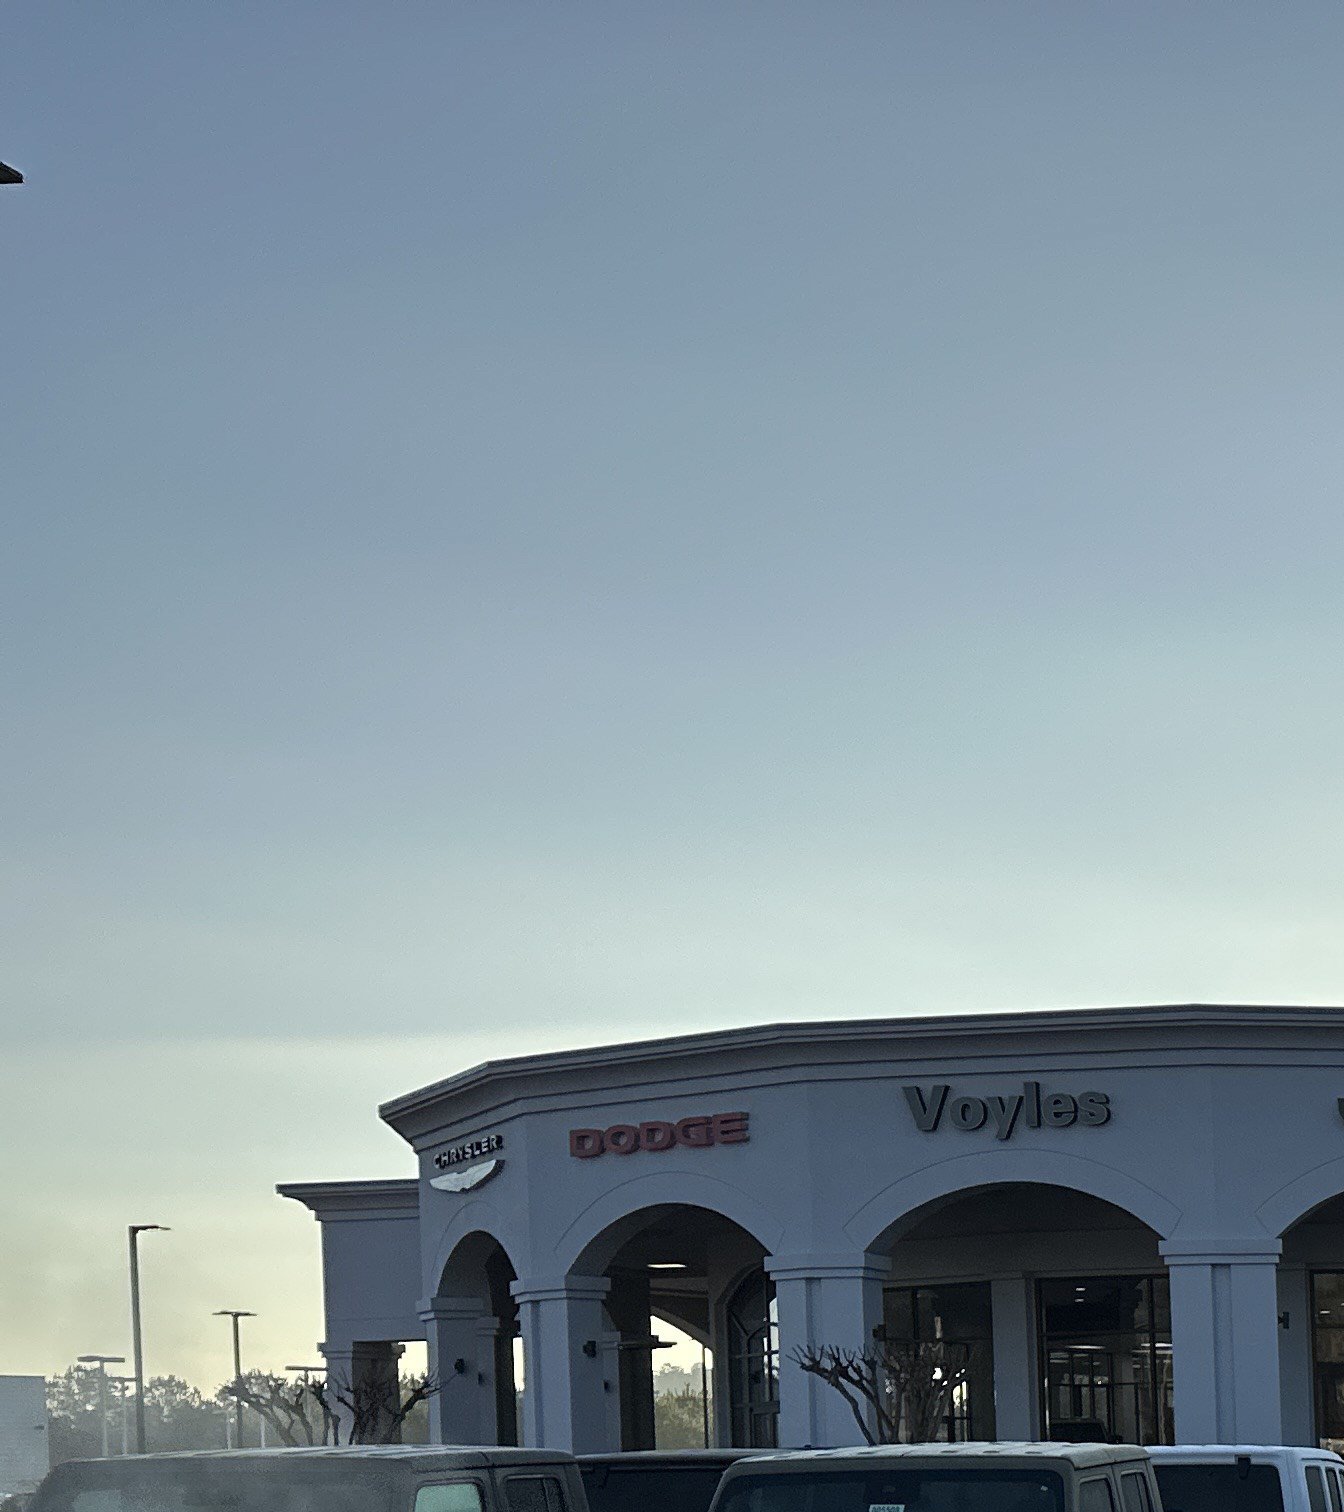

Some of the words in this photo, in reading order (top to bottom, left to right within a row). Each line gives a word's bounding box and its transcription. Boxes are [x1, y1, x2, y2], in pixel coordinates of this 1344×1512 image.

[902, 1081, 1112, 1140] Voyles
[433, 1134, 503, 1169] CHRYSLER
[569, 1111, 750, 1159] DODGE
